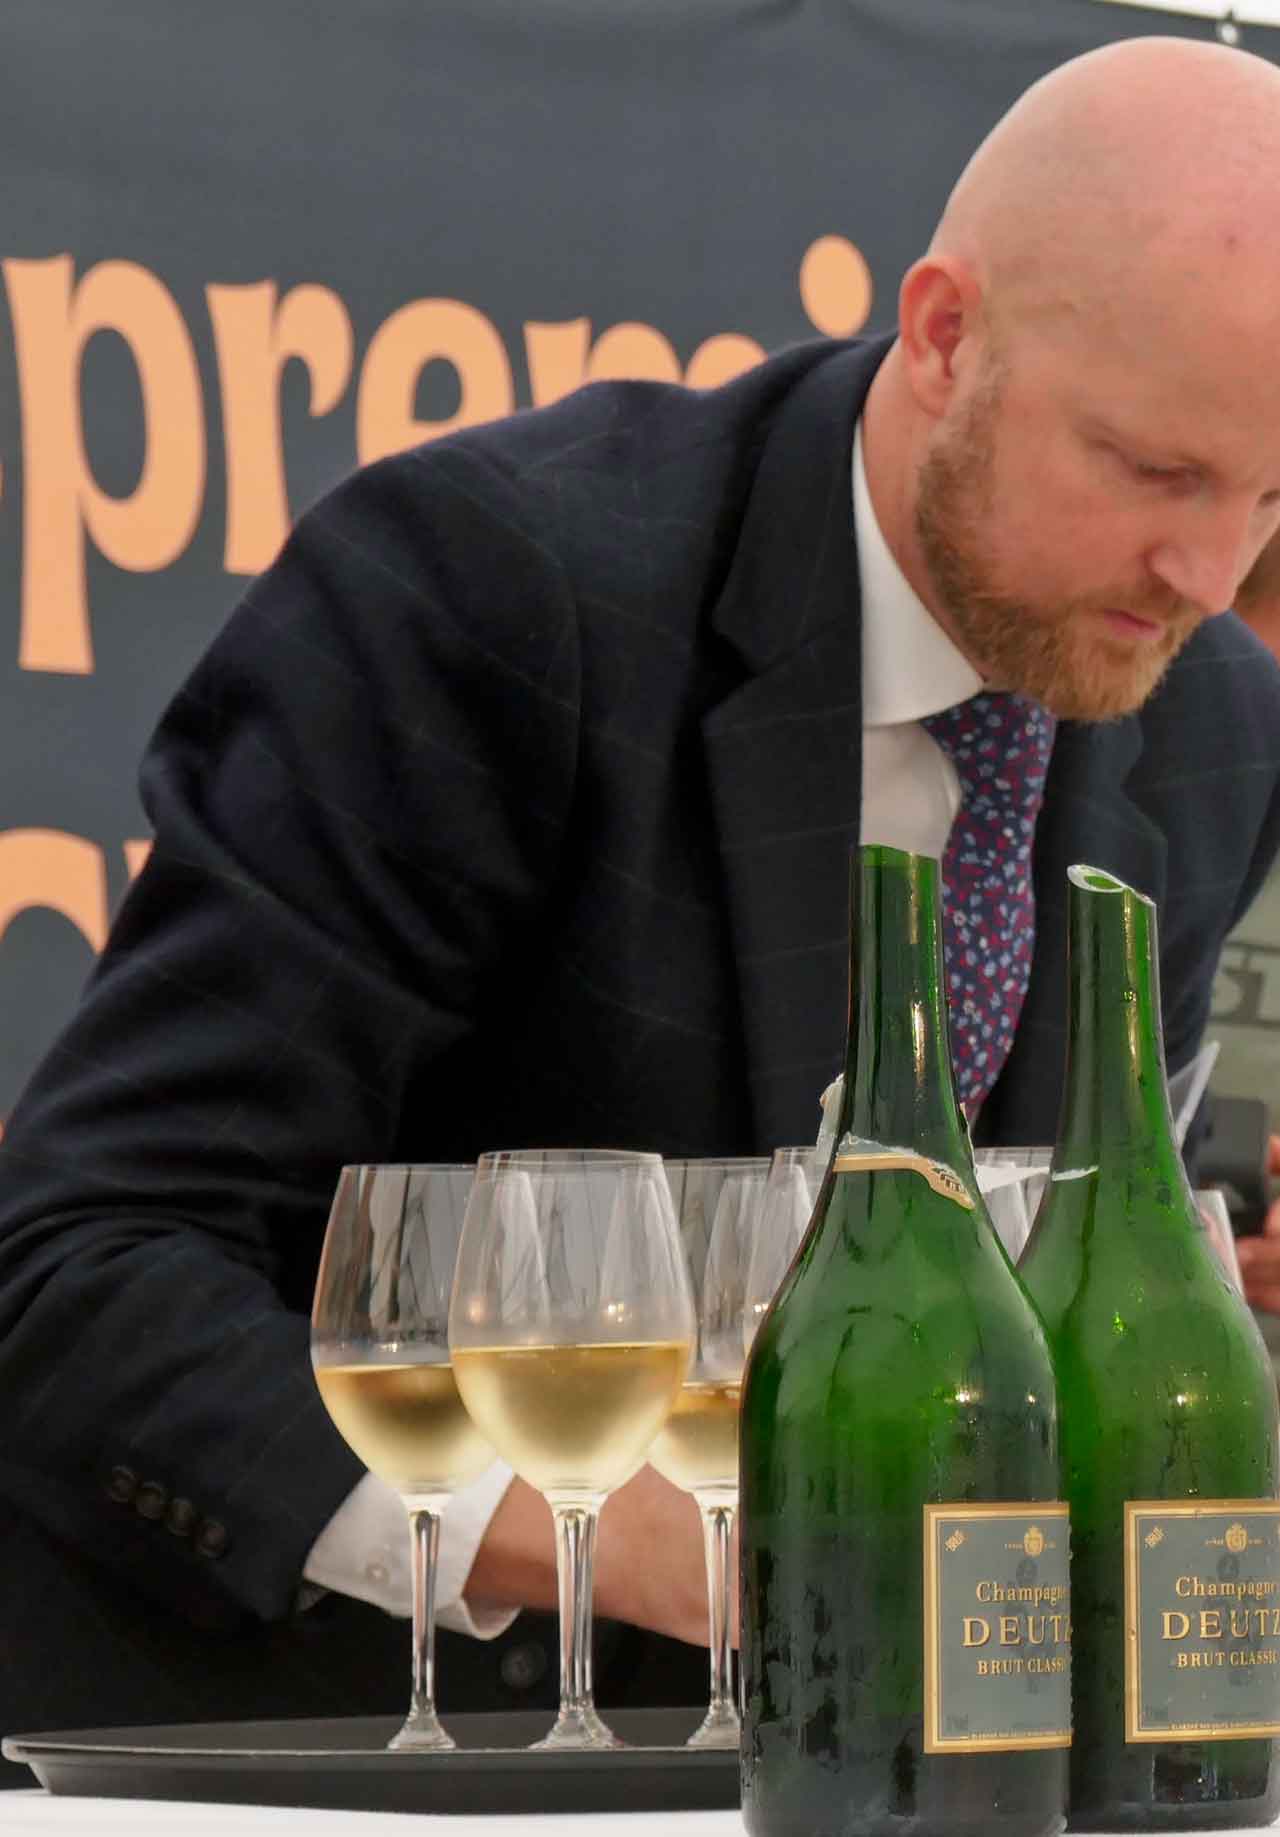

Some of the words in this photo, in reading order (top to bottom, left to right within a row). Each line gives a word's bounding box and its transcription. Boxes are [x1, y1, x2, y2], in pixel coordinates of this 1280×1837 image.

[1160, 1607, 1280, 1640] DEUTZ
[977, 1658, 1023, 1676] BRUT
[1176, 1651, 1225, 1668] BRUT
